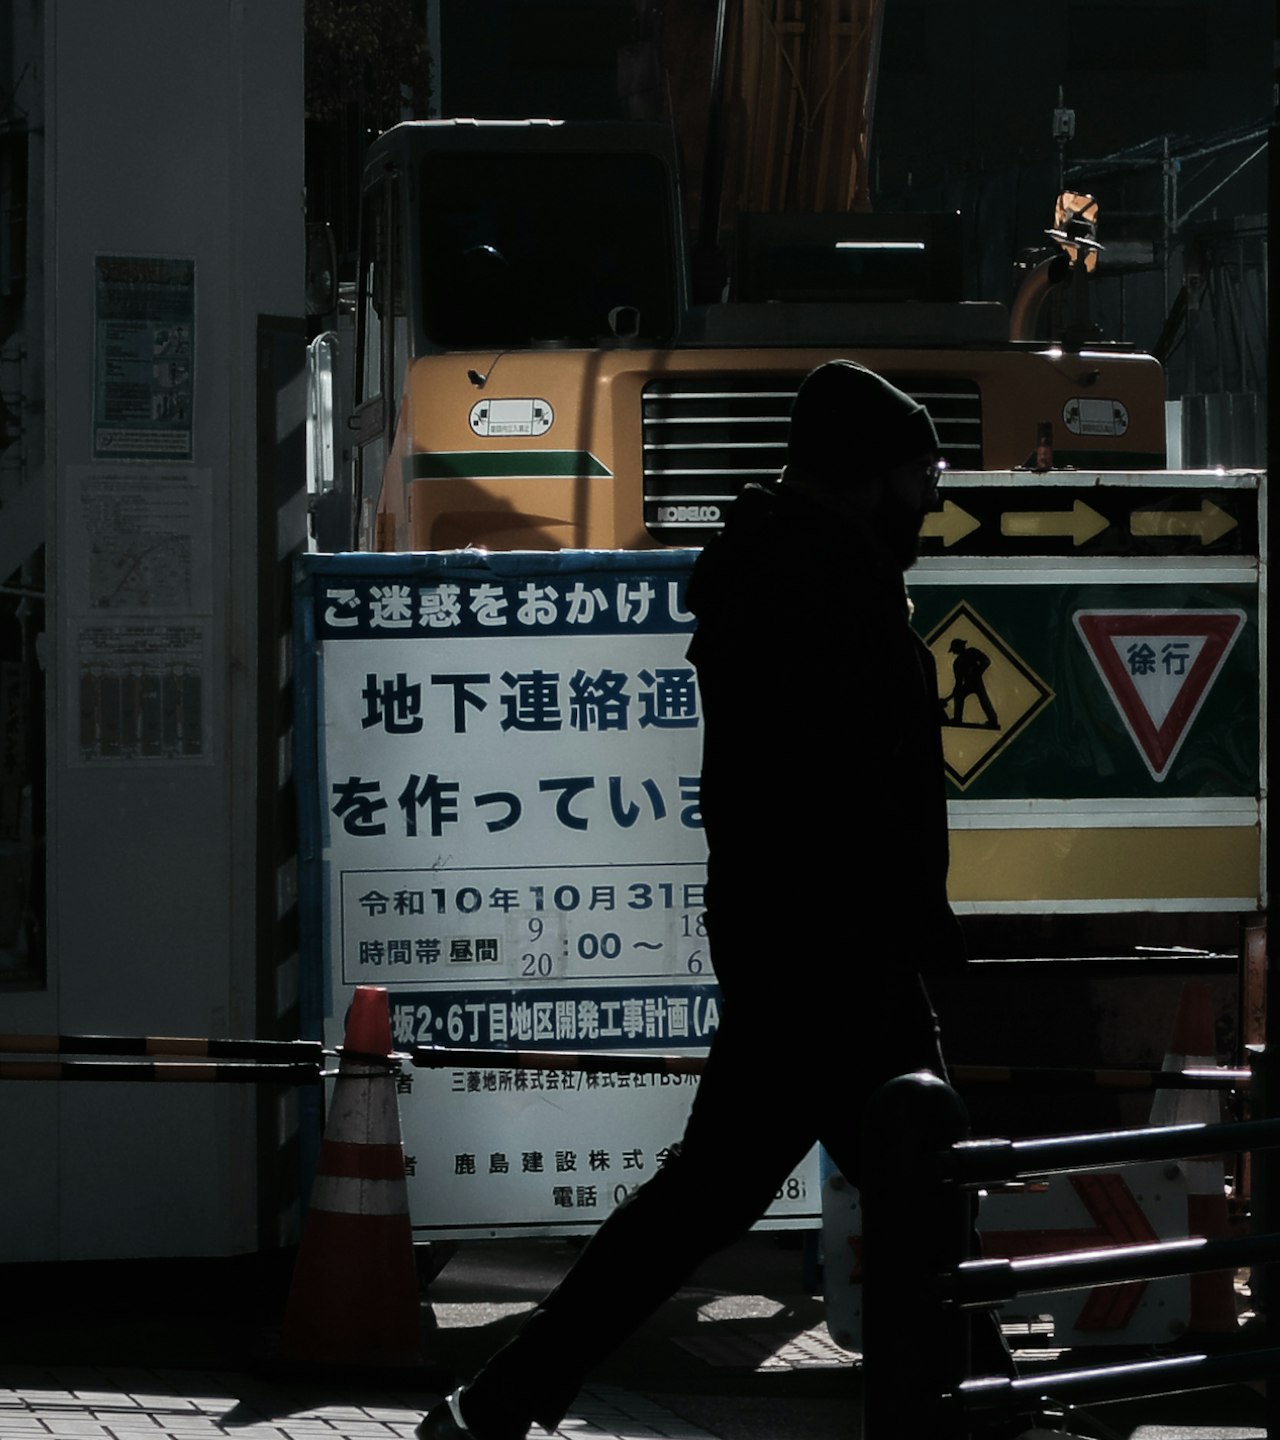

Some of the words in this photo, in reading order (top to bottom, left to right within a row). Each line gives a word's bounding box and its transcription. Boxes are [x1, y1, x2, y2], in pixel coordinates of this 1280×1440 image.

[657, 505, 722, 522] KOBELCO
[324, 582, 697, 628] ご迷惑をおかけし
[1127, 643, 1190, 675] 徐行
[361, 669, 700, 734] 地下連絡通
[359, 883, 706, 917] 令和10年10月31日
[528, 917, 544, 942] 9
[521, 952, 553, 977] 20
[687, 949, 703, 975] 6
[389, 995, 720, 1044] 坂2・6丁目地区開発工事計画(A
[553, 1185, 598, 1208] 電話
